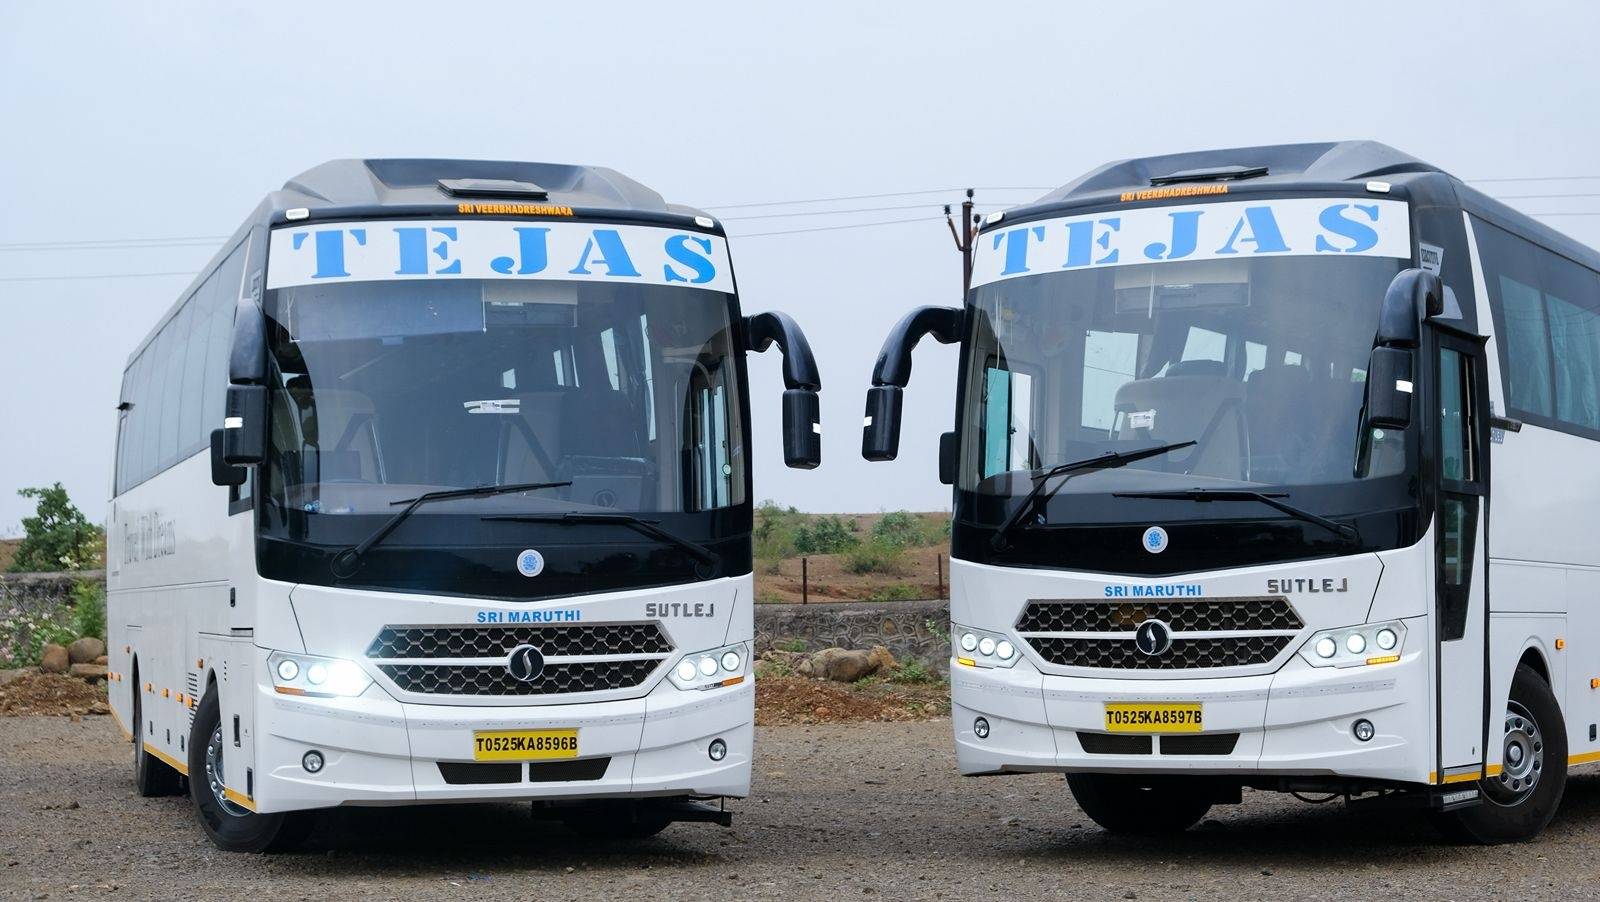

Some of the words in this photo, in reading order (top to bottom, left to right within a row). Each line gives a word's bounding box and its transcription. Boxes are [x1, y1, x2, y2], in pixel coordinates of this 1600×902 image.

[1120, 191, 1135, 202] SRI
[458, 203, 474, 214] SRI
[476, 204, 574, 216] VEERBHADRESHWARA
[993, 203, 1381, 276] TEJAS
[292, 226, 717, 284] TEJAS
[1104, 585, 1129, 597] SRI
[1132, 584, 1203, 597] MARUTHI
[1266, 577, 1348, 594] SUTLEJ
[477, 611, 504, 623] SRI
[508, 609, 581, 623] MARUTHI
[645, 602, 715, 618] SUTLEJ
[1106, 710, 1203, 725] T0525KA8597B
[475, 736, 578, 752] T0525KA8596B
